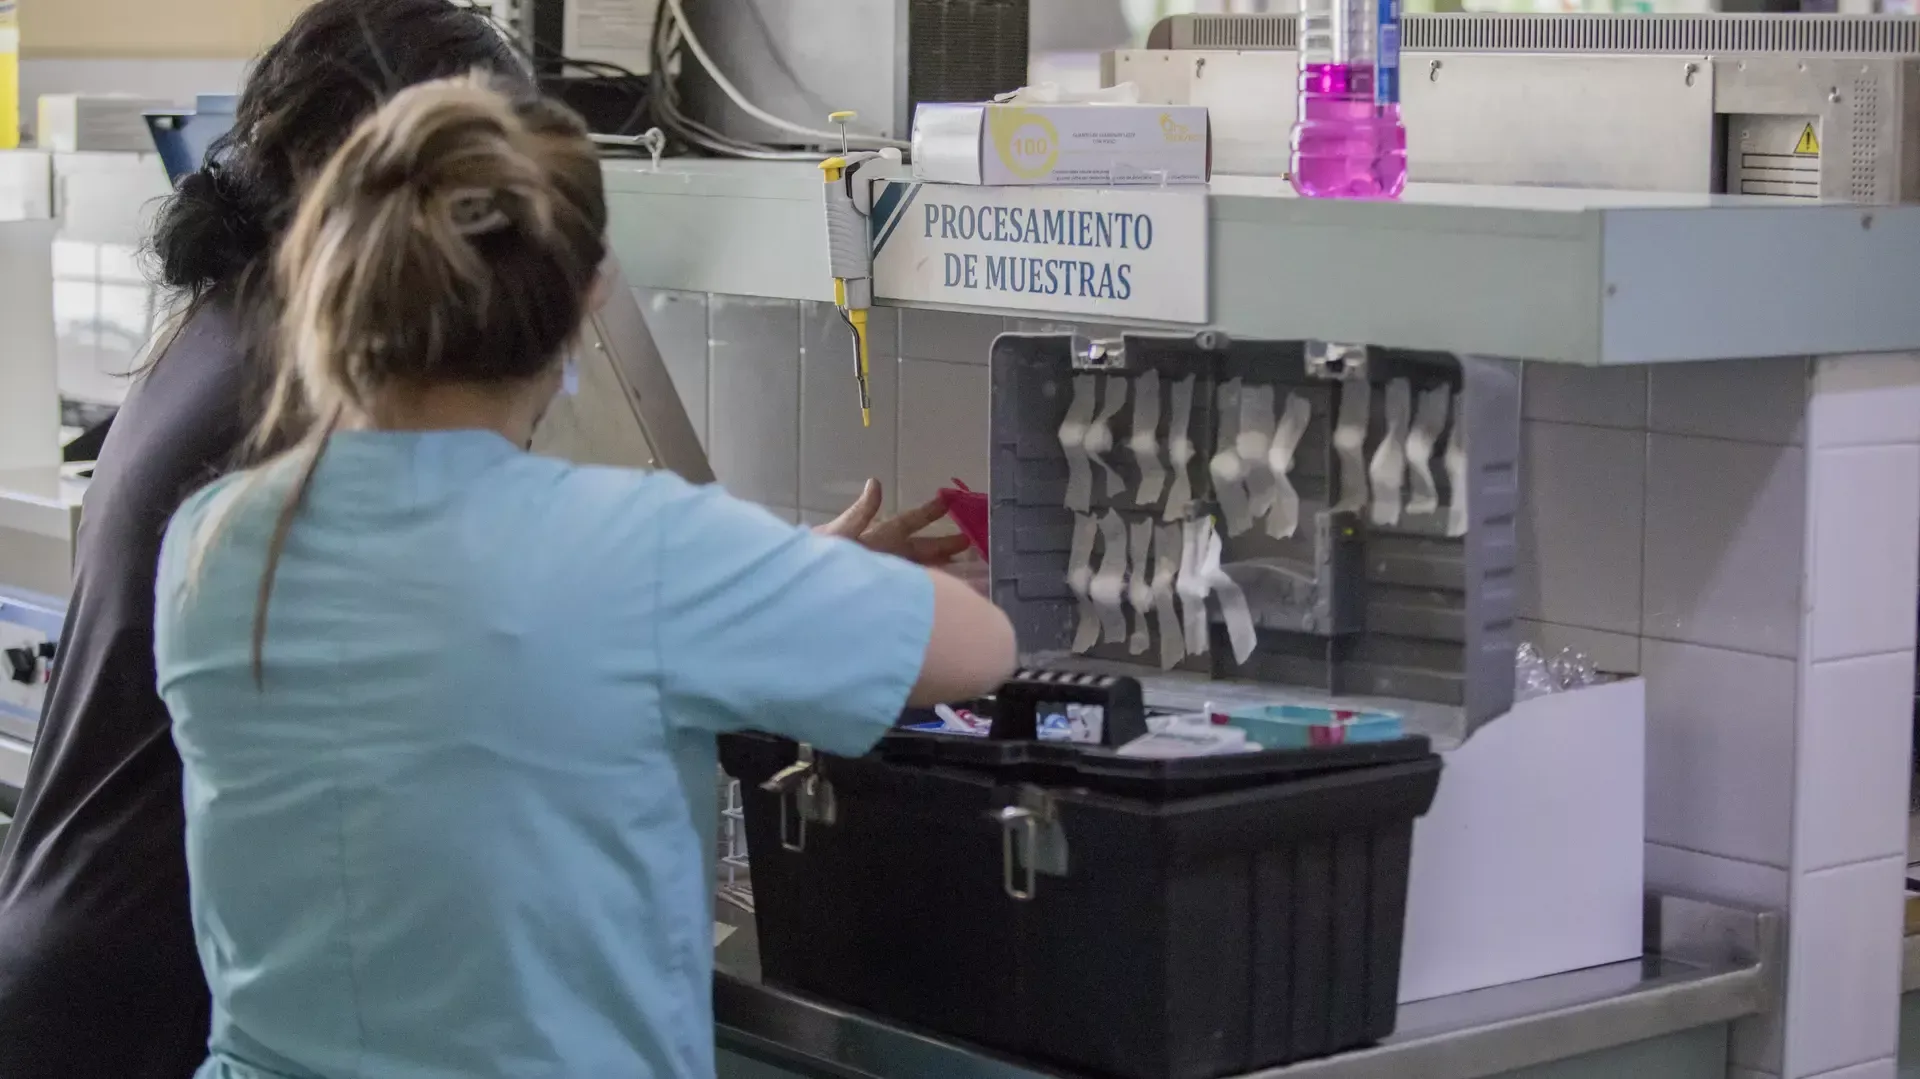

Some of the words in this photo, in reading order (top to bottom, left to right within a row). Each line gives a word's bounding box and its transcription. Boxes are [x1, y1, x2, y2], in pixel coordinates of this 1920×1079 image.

[1013, 137, 1047, 156] 100
[924, 203, 1153, 250] PROCESAMIENTO
[943, 252, 978, 289] DE
[985, 255, 1131, 300] MUESTRAS
